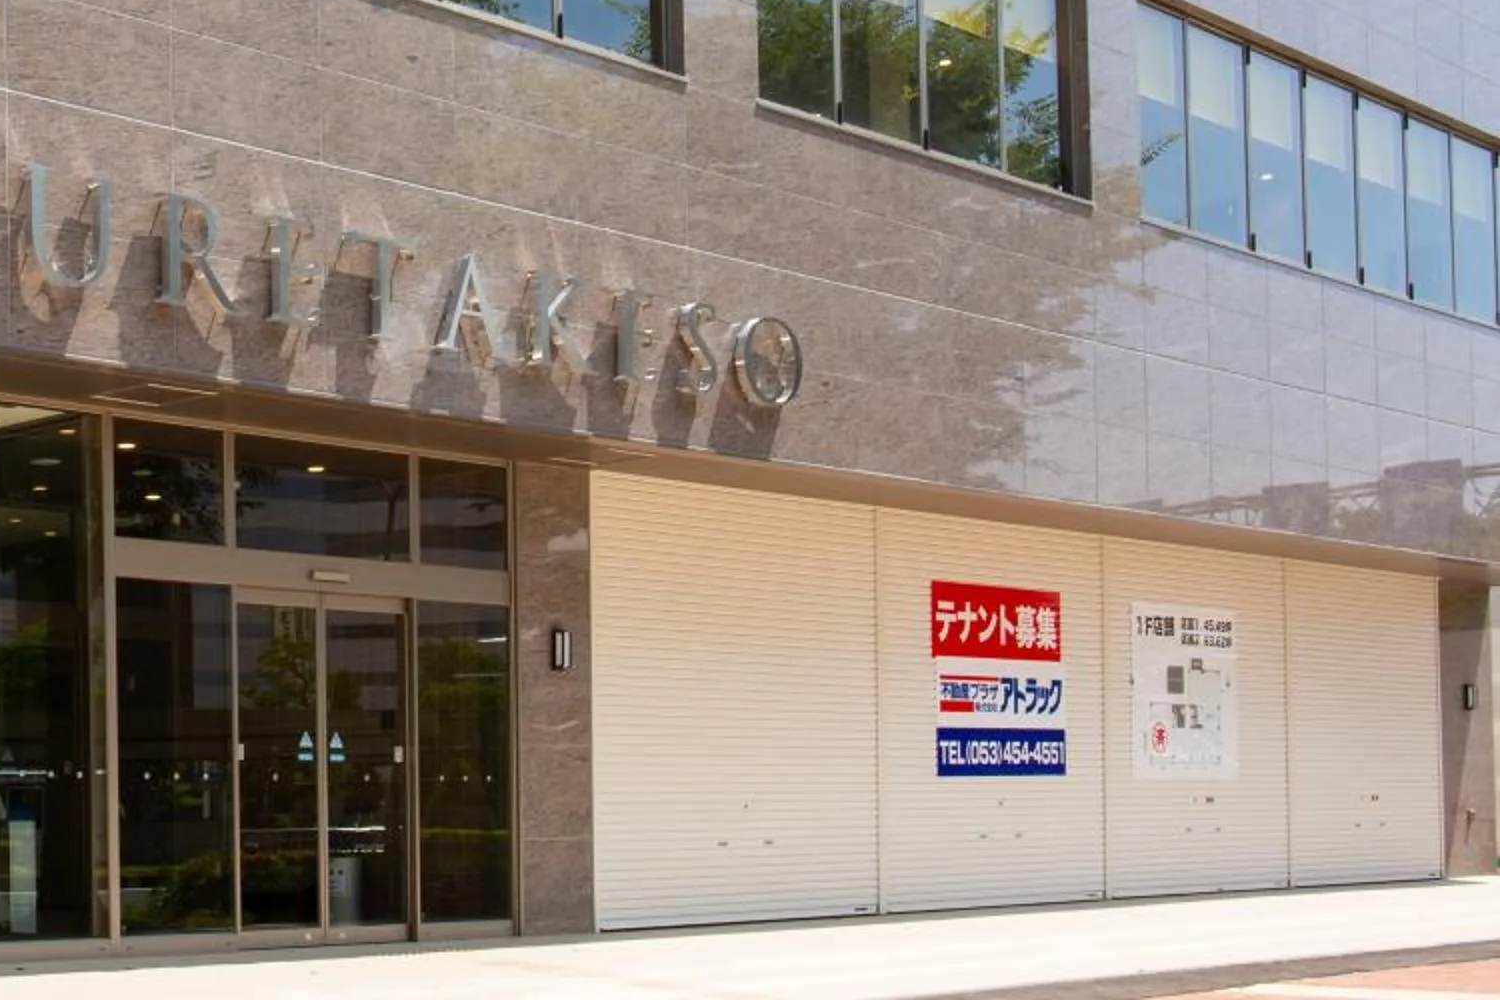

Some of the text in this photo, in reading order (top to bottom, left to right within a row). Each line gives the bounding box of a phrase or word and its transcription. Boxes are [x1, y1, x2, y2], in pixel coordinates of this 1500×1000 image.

[935, 600, 1058, 649] テナント募集
[1000, 678, 1063, 714] アトラック
